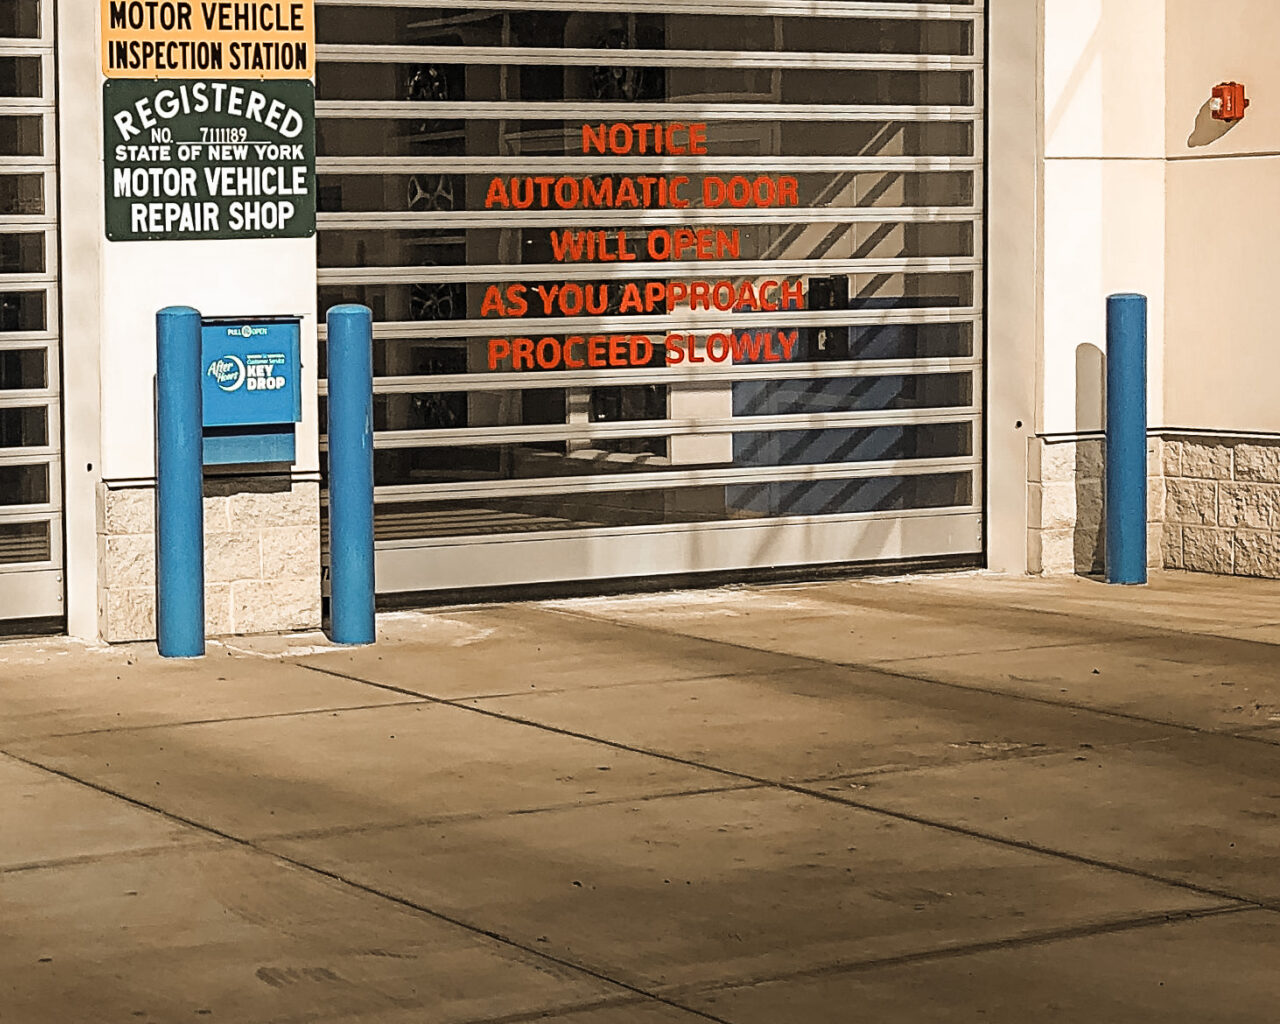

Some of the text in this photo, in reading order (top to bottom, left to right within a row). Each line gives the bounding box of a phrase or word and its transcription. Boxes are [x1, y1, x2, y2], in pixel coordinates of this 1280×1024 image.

[109, 1, 304, 32] MOTOR VEHICLE
[108, 40, 307, 70] INSPECTION STATION
[113, 82, 304, 142] REGISTERED
[151, 127, 248, 144] NO. 7111189
[582, 122, 708, 156] NOTICE
[115, 144, 304, 162] STATE OF NEW YORK
[113, 166, 308, 198] MOTOR VEHICLE
[484, 175, 799, 210] AUTOMATIC DOOR
[131, 201, 295, 233] REPAIR SHOP
[550, 228, 740, 262] WILL OPEN
[480, 280, 805, 318] AS YOU APPROACH
[487, 330, 798, 371] PROCEED SLOWLY
[207, 359, 234, 377] After
[247, 364, 274, 377] KEY
[247, 377, 286, 391] DROP
